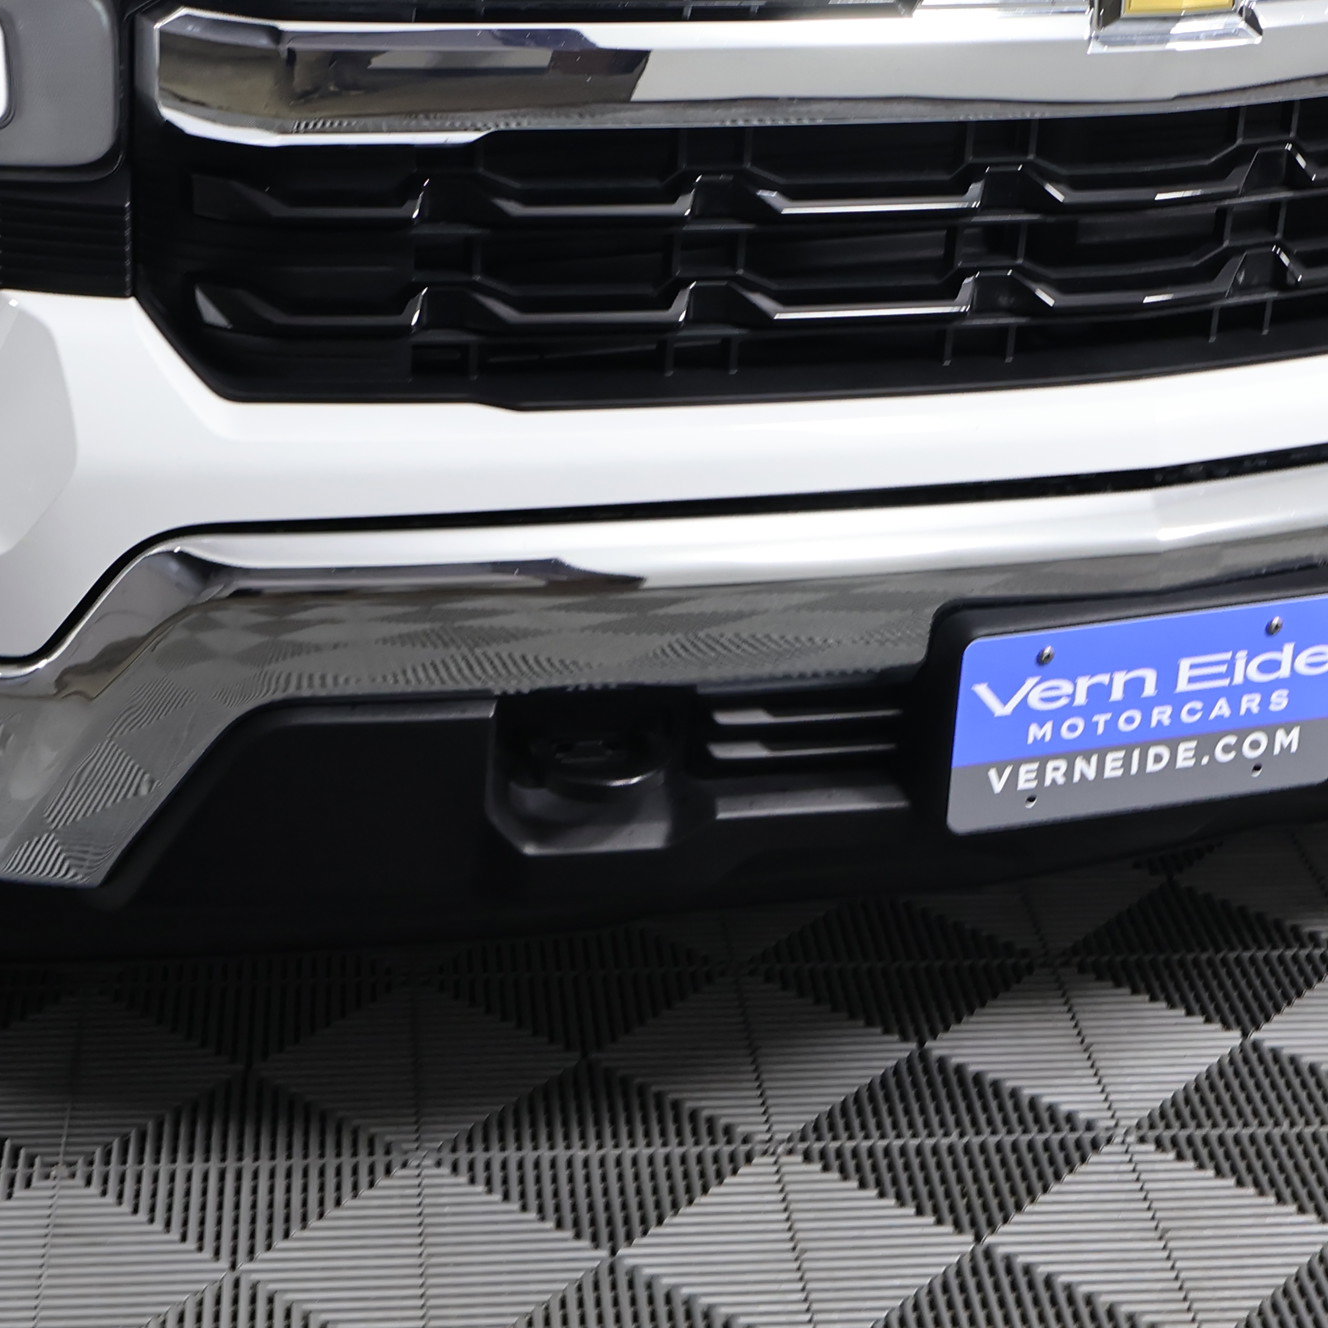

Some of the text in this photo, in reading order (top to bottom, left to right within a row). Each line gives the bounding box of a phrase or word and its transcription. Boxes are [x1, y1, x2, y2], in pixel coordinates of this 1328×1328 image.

[972, 667, 1158, 718] Vern
[1027, 689, 1290, 745] MOTORCARS
[987, 726, 1302, 795] VERNEIDE.COM
